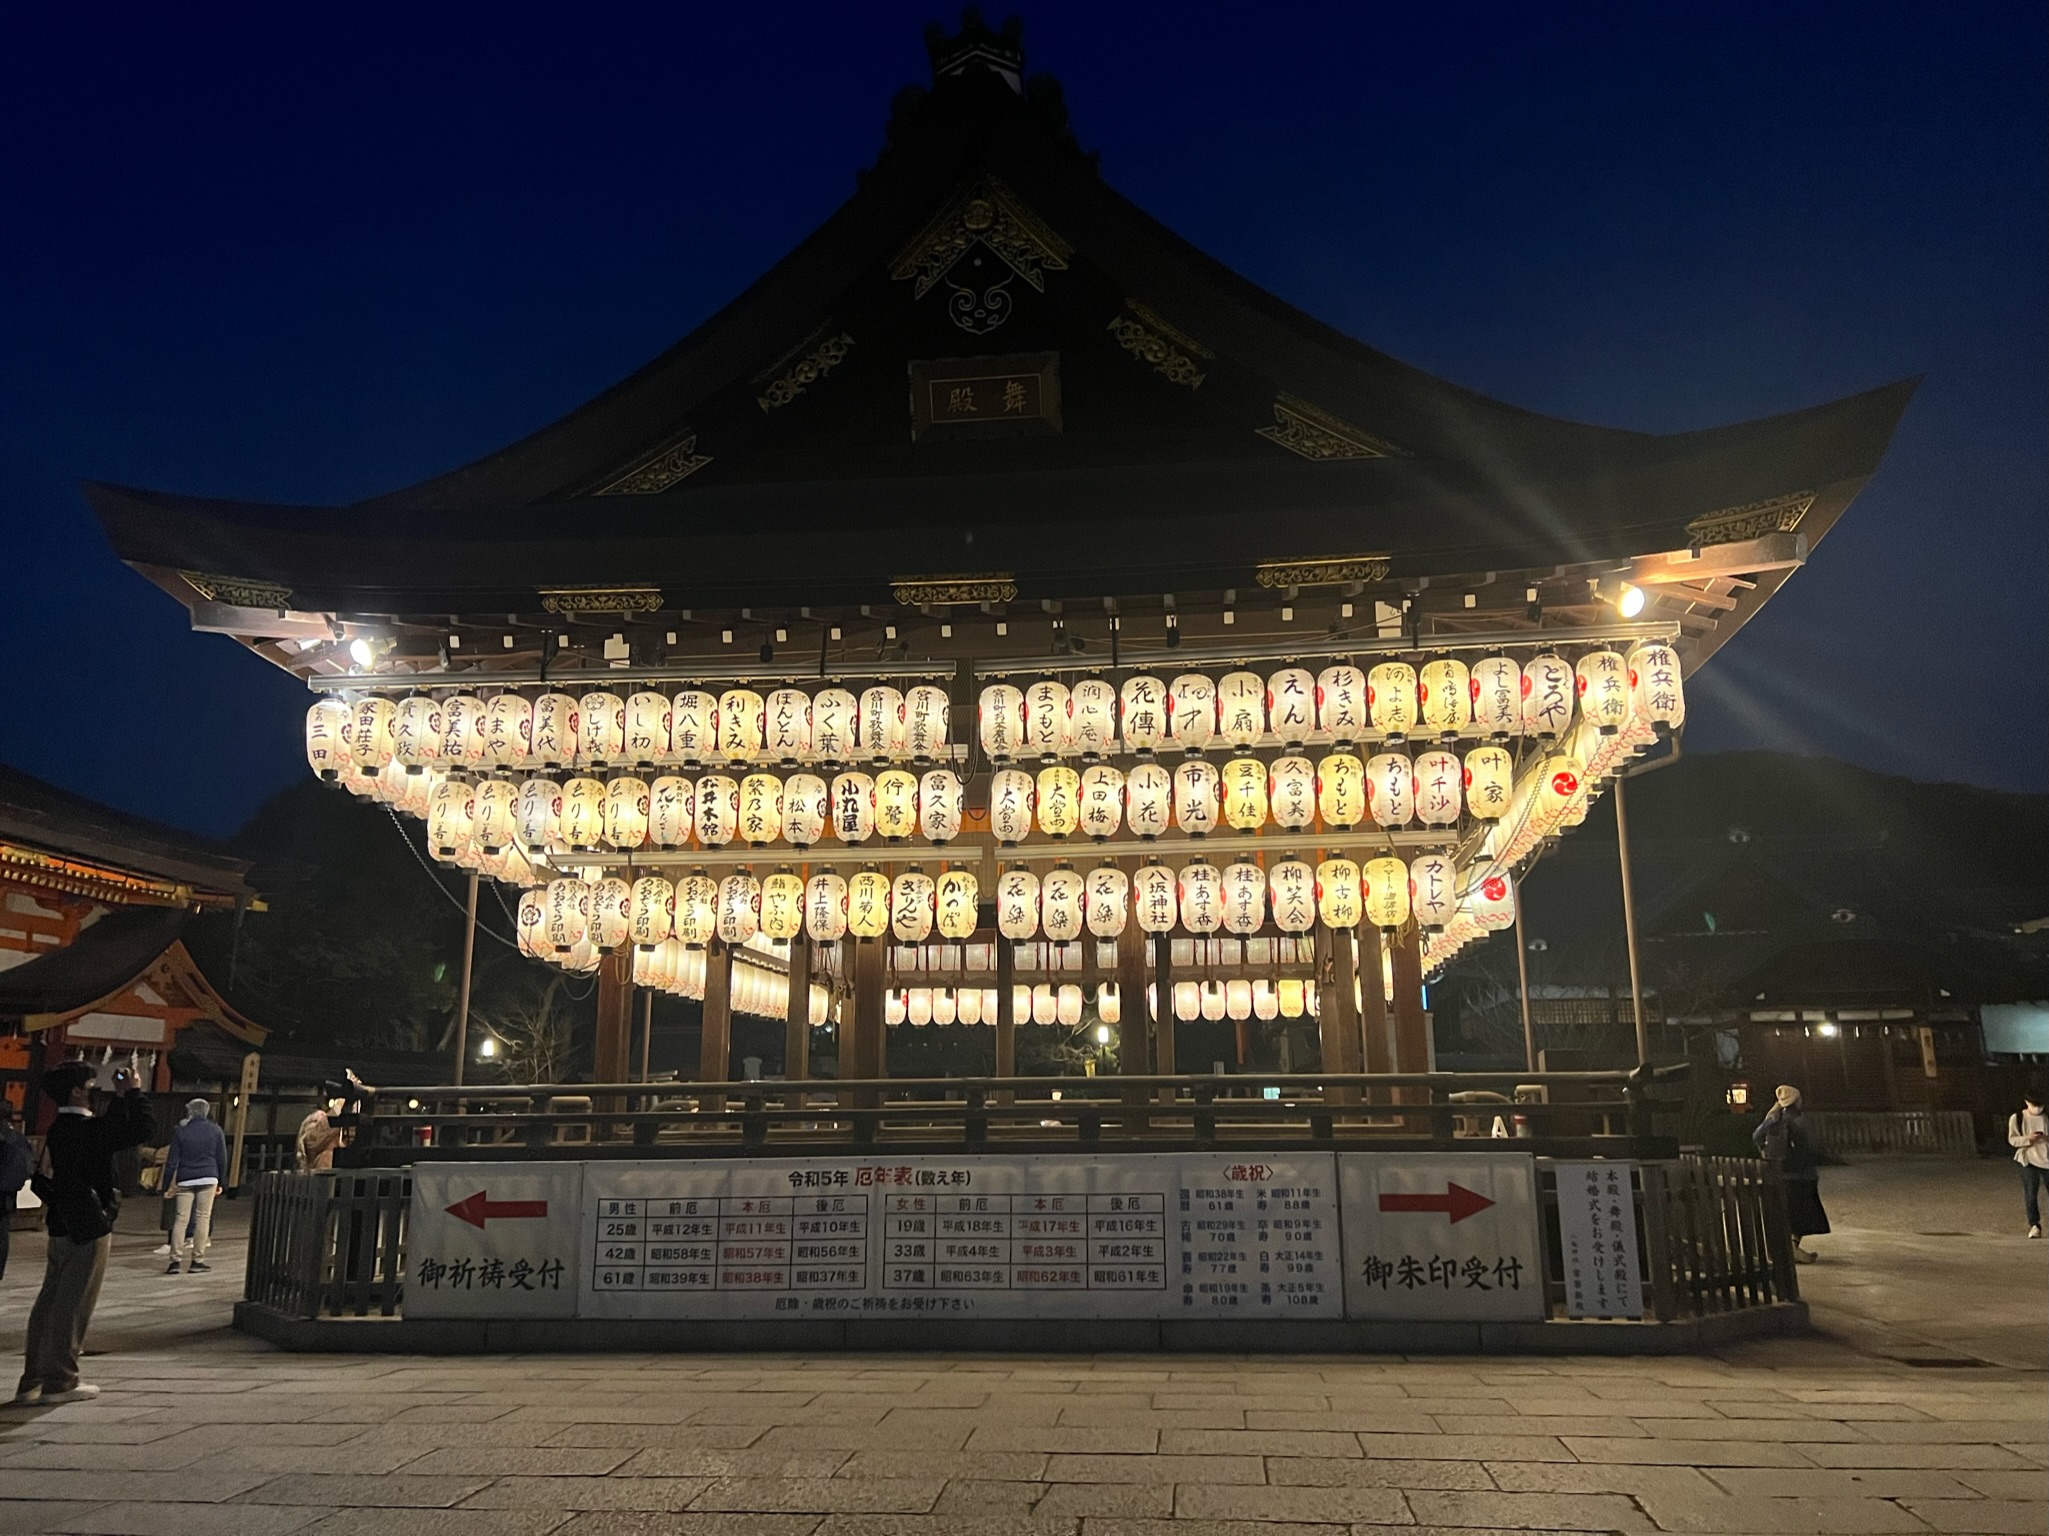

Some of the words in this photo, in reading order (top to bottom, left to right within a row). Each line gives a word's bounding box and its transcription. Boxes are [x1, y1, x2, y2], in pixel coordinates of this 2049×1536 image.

[1598, 656, 1623, 716] 権兵衛
[1648, 649, 1676, 711] 権兵衛
[1284, 673, 1305, 724] えん
[1332, 670, 1356, 726] 杉きみ
[1385, 668, 1406, 723] 河よ志
[1130, 682, 1155, 736] 花傳
[1231, 680, 1253, 733] 小扇
[776, 693, 794, 748] ほんとん
[1037, 686, 1055, 743] まつもと
[442, 698, 462, 757] 富美祐
[487, 698, 506, 754] たまや
[538, 696, 558, 751] 富美代
[631, 696, 651, 749] いし初
[680, 694, 698, 749] 堀八重
[726, 696, 745, 750] 利きみ
[819, 693, 841, 753] ふく葉
[355, 702, 377, 756] 家田荘子
[1429, 757, 1450, 811] 叶千沙
[1481, 753, 1504, 803] 叶家
[1238, 763, 1257, 817] 豆千佳
[1285, 760, 1304, 818] 久富美
[1334, 758, 1350, 816] ちもと
[1387, 757, 1402, 816] ちもと
[1088, 773, 1110, 823] 上田梅
[1138, 773, 1159, 822] 小花
[1182, 765, 1207, 822] 市光
[842, 779, 859, 832] 小丸屋
[928, 774, 948, 830] 富久家
[788, 799, 806, 834] 松本
[1332, 864, 1353, 920] 柳古柳
[1425, 860, 1446, 913] カトレヤ
[858, 876, 874, 927] 西川菊人
[1149, 870, 1168, 924] 八坂神社
[1192, 869, 1212, 926] 桂あす香
[1235, 867, 1253, 927] 桂あす香
[1282, 866, 1305, 924] 柳笑会
[813, 878, 830, 931] 井上隆保
[789, 1171, 848, 1188] 令和5年
[1196, 1189, 1244, 1198] 昭和38年生
[1271, 1188, 1320, 1198] 昭和11年生
[816, 1200, 844, 1212] 後厄
[897, 1198, 926, 1211] 女性
[959, 1198, 988, 1211] 前厄
[1035, 1198, 1064, 1211] 本厄
[1111, 1198, 1140, 1210] 後厄
[1209, 1201, 1233, 1211] 61歳
[1257, 1189, 1267, 1211] 米寿
[1285, 1200, 1310, 1210] 88歳
[608, 1202, 636, 1215] 男性
[670, 1202, 698, 1214] 前厄
[742, 1201, 771, 1213] 本厄
[607, 1223, 637, 1236] 25歳
[653, 1223, 712, 1236] 平成12年生
[725, 1222, 786, 1235] 平成11年生
[799, 1221, 860, 1234] 平成10年生
[897, 1219, 925, 1233] 19歳
[943, 1219, 1003, 1233] 平成18年生
[1095, 1219, 1157, 1232] 平成16年生
[1197, 1220, 1245, 1230] 昭和29年生
[1273, 1220, 1321, 1229] 昭和9年生
[1210, 1232, 1235, 1242] 70歳
[1285, 1232, 1312, 1241] 90歳
[1586, 1170, 1608, 1308] 結婚式をお受けします
[605, 1248, 635, 1260] 42歳
[651, 1247, 711, 1260] 昭和58年生
[723, 1247, 785, 1259] 昭和57年生
[797, 1246, 859, 1258] 昭和56年生
[894, 1244, 925, 1257] 33歳
[946, 1245, 1000, 1257] 平成4年生
[1022, 1245, 1077, 1257] 平成3年生
[1099, 1245, 1153, 1257] 平成2年生
[1198, 1252, 1247, 1261] 昭和22年生
[1275, 1252, 1323, 1260] 大正14年生
[1211, 1264, 1236, 1273] 77歳
[1260, 1252, 1269, 1273] 白寿
[1288, 1263, 1313, 1272] 99歳
[418, 1258, 564, 1290] 御祈祷受付
[603, 1272, 634, 1285] 61歳
[649, 1272, 709, 1284] 昭和39年生
[722, 1272, 783, 1284] 昭和38年生
[797, 1271, 858, 1283] 昭和37年生
[893, 1270, 925, 1283] 37歳
[941, 1270, 1004, 1283] 昭和63年生
[1017, 1270, 1080, 1283] 昭和62年生
[1094, 1271, 1159, 1283] 昭和61年生
[1362, 1255, 1523, 1290] 御朱印受付
[1199, 1284, 1248, 1293] 昭和19年生
[1278, 1283, 1324, 1292] 大正5年生
[1212, 1295, 1238, 1305] 80歳
[1288, 1295, 1318, 1304] 108歳
